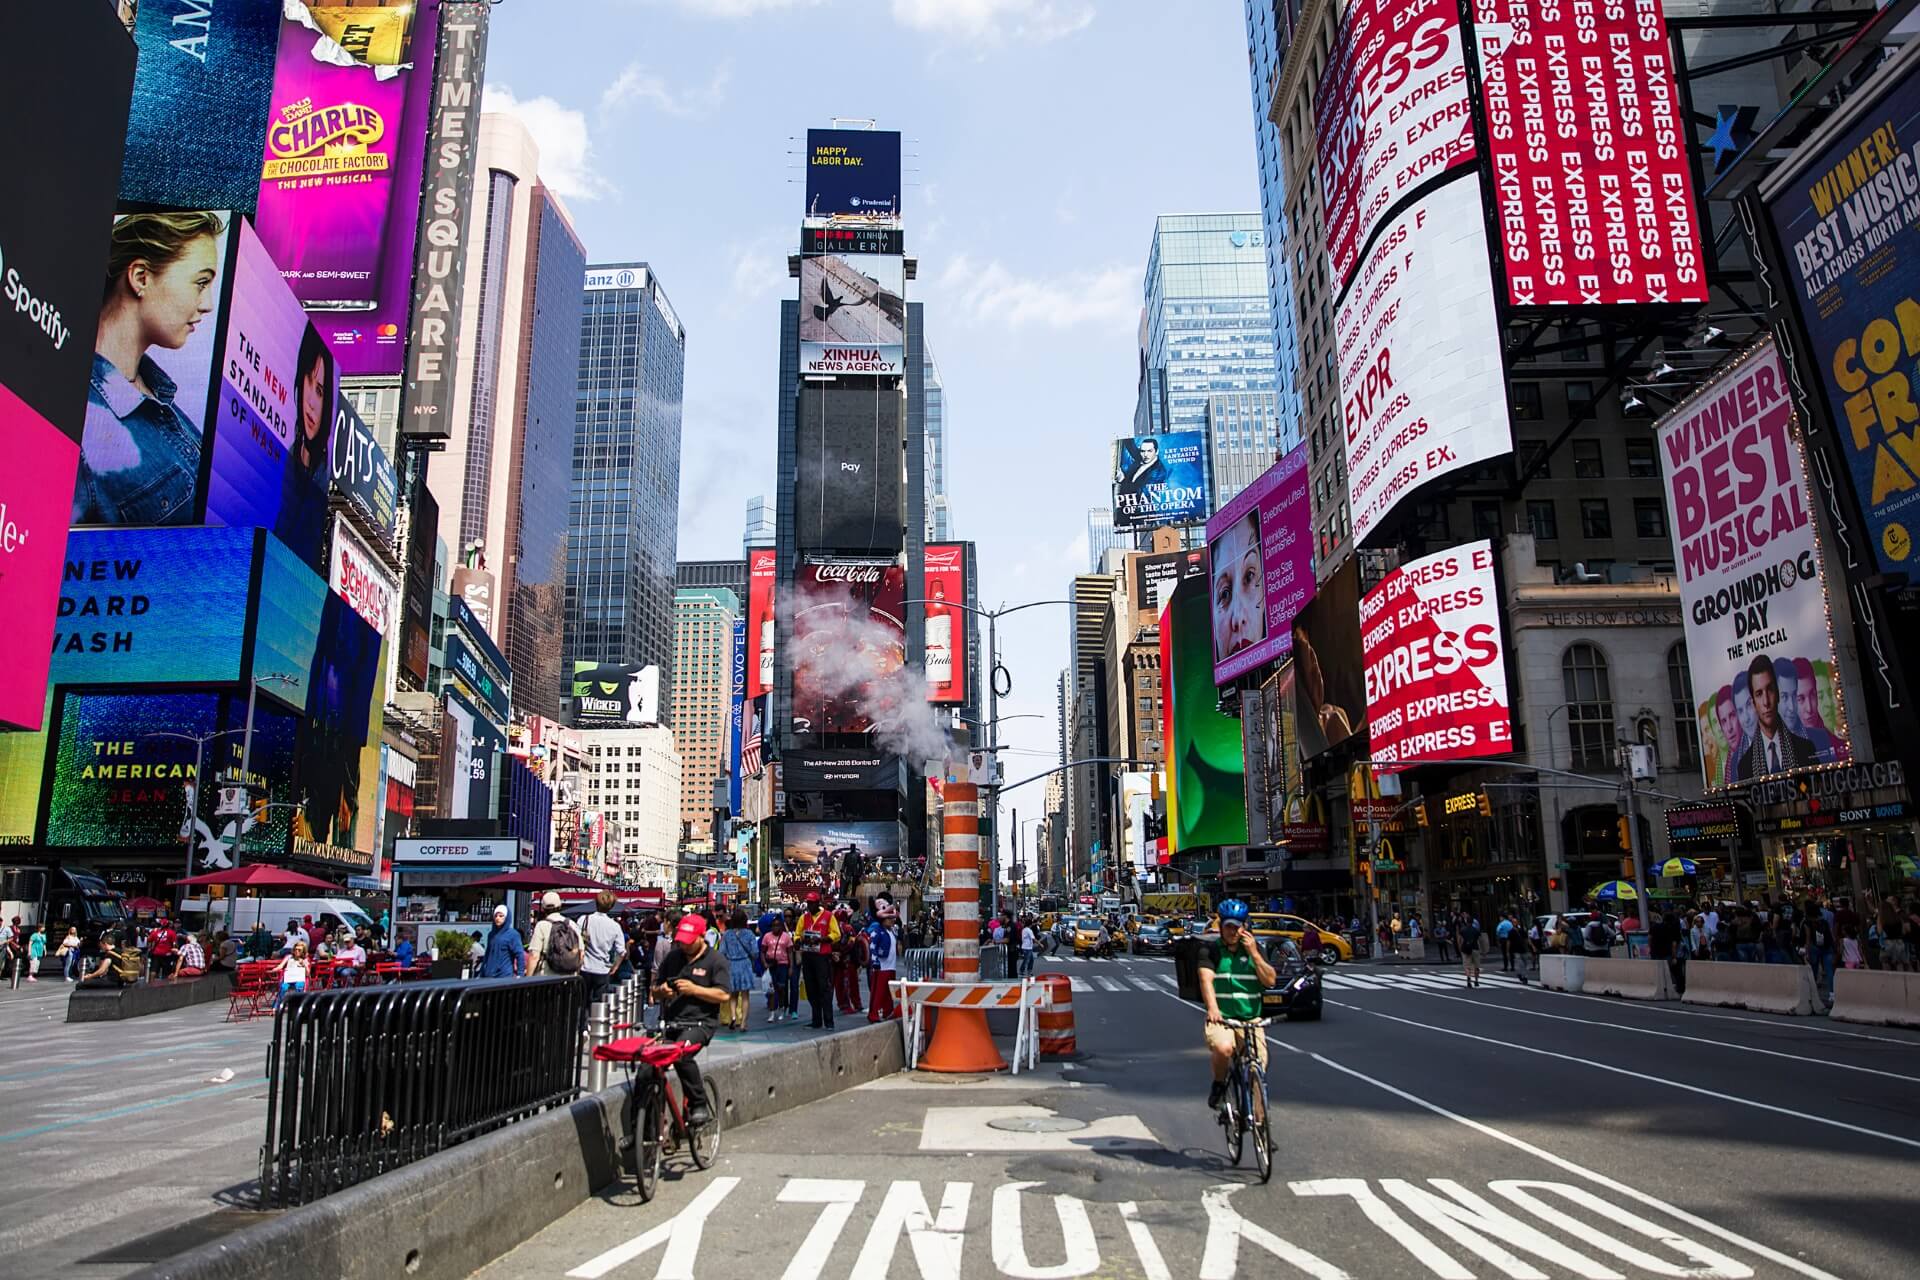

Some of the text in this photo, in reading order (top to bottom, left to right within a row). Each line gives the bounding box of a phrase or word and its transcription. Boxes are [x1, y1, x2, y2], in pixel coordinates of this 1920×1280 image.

[1337, 12, 1370, 86] EXPRESS
[1345, 29, 1385, 103] EXPRESS
[1482, 37, 1513, 141] EXPRESS
[272, 107, 377, 152] CHARLIE
[1322, 18, 1449, 210] EXPRESS
[279, 155, 384, 175] CHOCOLATE FACTORY
[811, 156, 864, 167] LABOR DAY.
[816, 147, 848, 156] HAPPY
[1348, 122, 1383, 189] EXPRESS
[1544, 35, 1578, 139] EXPRESS
[1561, 152, 1596, 262] EXPRESS
[1609, 33, 1643, 138] EXPRESS
[1626, 150, 1661, 261] EXPRESS
[278, 174, 373, 190] THE NEW MUSICAL
[1516, 58, 1566, 287] EXPRESS EXPRESS
[1581, 56, 1633, 285] EXPRESS EXPRESS
[1643, 55, 1697, 284] EXPRESS EXPRESS
[1809, 120, 1901, 219] WINNER!
[416, 24, 478, 382] TIMES SQUARE
[1330, 205, 1355, 260] EXPRESS
[1356, 142, 1398, 209] EXPRESS
[1354, 186, 1390, 250] EXPRESS
[1496, 153, 1530, 263] EXPRESS
[816, 241, 888, 251] GALLERY
[856, 231, 888, 240] XINHUA
[1364, 224, 1407, 288] EXPRESS
[1794, 210, 1844, 280] BEST
[1804, 277, 1825, 300] ALL
[1825, 240, 1866, 281] ACROSS
[1865, 210, 1903, 253] NORTH
[316, 271, 370, 279] SEMI-SWEET
[1362, 266, 1398, 326] EXPRESS
[4, 267, 68, 350] Spotify
[239, 332, 287, 405] THE NEW
[808, 361, 896, 372] NEWS AGENCY
[823, 349, 882, 362] XINHUA
[1343, 344, 1369, 394] EXPRESS
[229, 360, 287, 439] STANDARD
[414, 404, 438, 415] NYC
[1665, 356, 1791, 468] WINNER!
[231, 398, 280, 462] OF WASH
[332, 409, 375, 484] CATS
[841, 462, 861, 473] Pay
[1163, 451, 1200, 460] FANTASIES
[1167, 457, 1196, 465] UNWIND
[1352, 417, 1429, 505] EXPRESS EXPRESS
[1671, 400, 1794, 541] BEST
[1115, 486, 1203, 509] PHANTOM
[1146, 483, 1168, 492] THE
[1263, 499, 1288, 525] Eyebrow
[1287, 484, 1306, 506] Lifted
[1379, 461, 1418, 510] EXPRESS
[1122, 501, 1196, 515] OF THE OPERA
[1264, 526, 1288, 547] Wrinkles
[1265, 532, 1297, 560] Diminished
[1681, 484, 1809, 582] MUSICAL
[1144, 561, 1177, 571] Show your
[1266, 560, 1293, 581] Pore Size
[1747, 551, 1762, 562] AWARD
[340, 549, 381, 618] SCHOOL
[1267, 572, 1295, 594] Reduced
[1287, 588, 1305, 605] Lines
[1387, 557, 1459, 601] EXPRESS
[1692, 551, 1816, 626] GROUNDHOG
[1270, 606, 1297, 628] Softened
[1363, 587, 1484, 655] EXPRESS EXPRESS
[1546, 611, 1671, 625] THE SHOW FOLKS
[1734, 601, 1769, 640] DAY
[733, 629, 746, 696] NOVOTEL
[1364, 624, 1499, 707] EXPRESS
[1727, 627, 1788, 662] THE MUSICAL
[1370, 686, 1494, 740] EXPRESS EXPRESS
[94, 741, 134, 756] THE
[1400, 725, 1476, 759] EXPRESS
[82, 764, 198, 779] AMERICAN
[1750, 759, 1902, 806] GIFTS LUGGAGE
[109, 788, 167, 803] JEAN
[1445, 792, 1477, 815] EXPRESS
[1840, 808, 1872, 822] SONY
[1671, 823, 1735, 839] CAMERA LUGGAGE
[1780, 818, 1802, 831] Nikon
[420, 845, 469, 855] COFFEED
[1767, 856, 1775, 883] ATM
